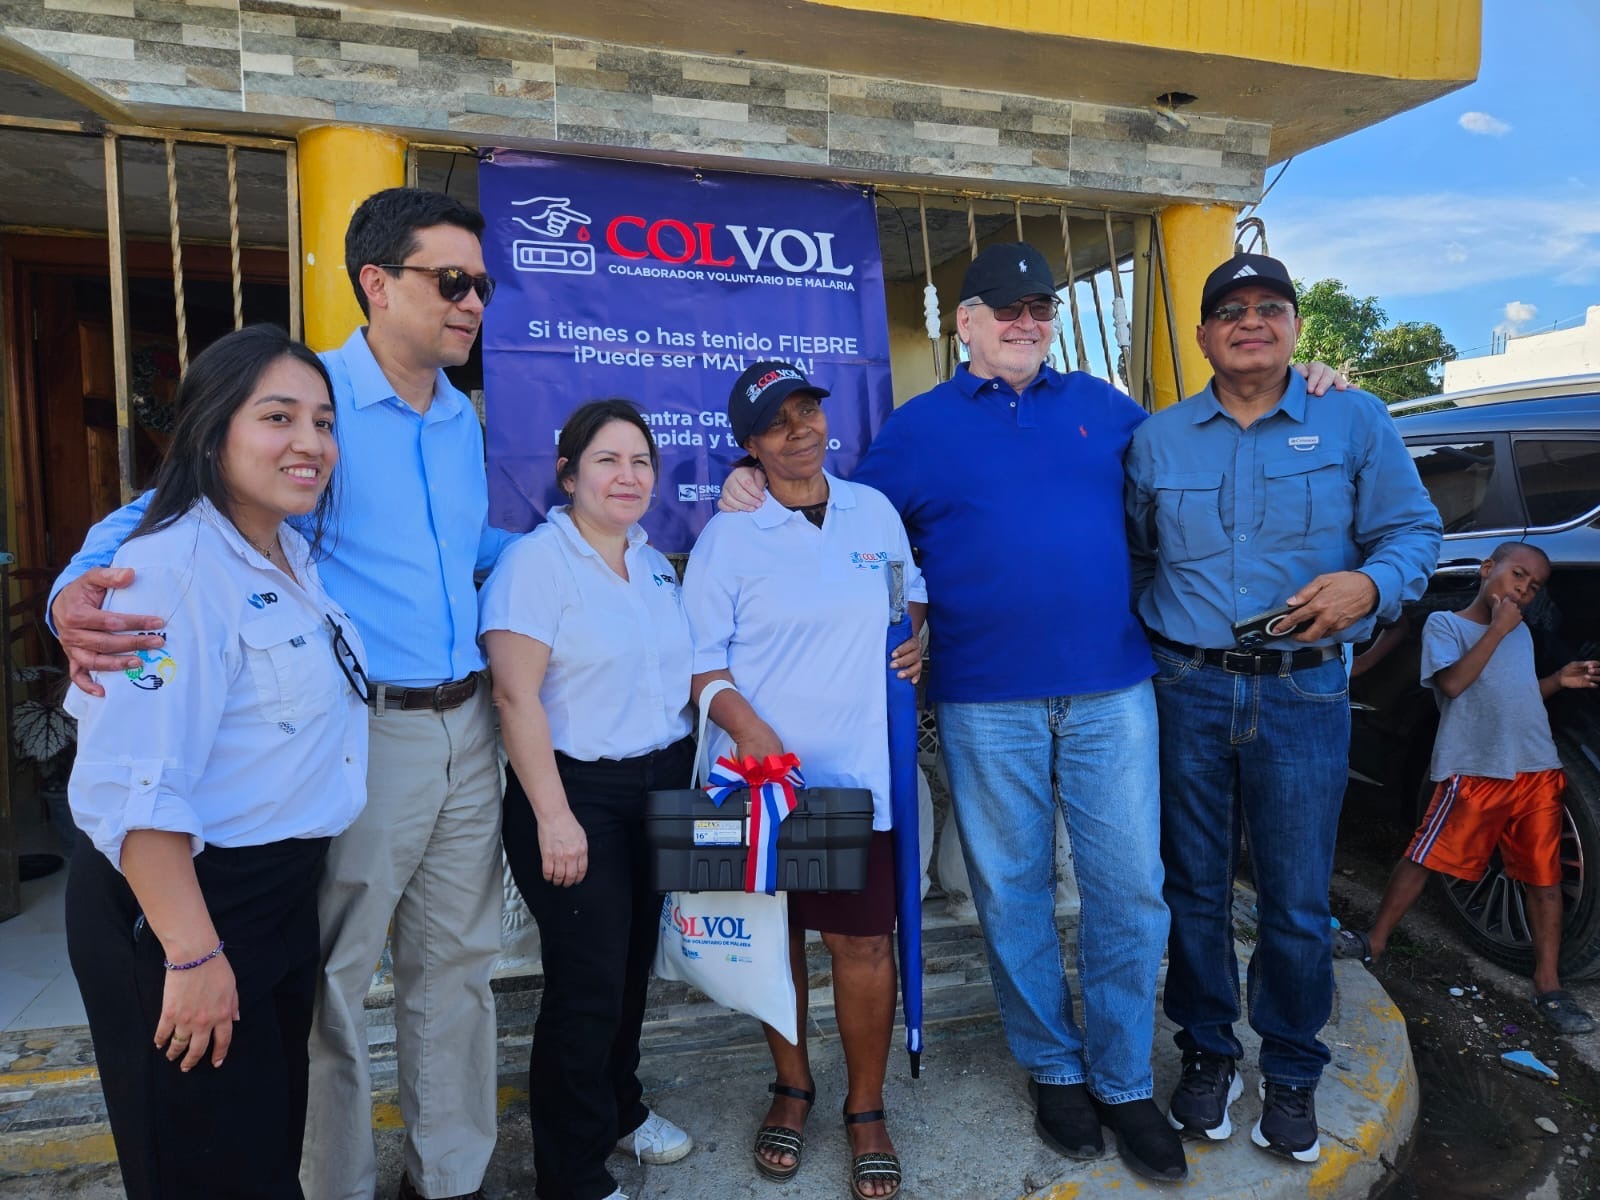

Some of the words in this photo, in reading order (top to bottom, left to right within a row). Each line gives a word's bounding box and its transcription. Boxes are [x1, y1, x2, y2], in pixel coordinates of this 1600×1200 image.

[606, 215, 854, 276] COLVOL
[608, 264, 704, 280] COLABORADOR
[706, 271, 784, 286] VOLUNTARIO
[786, 277, 803, 287] DE
[805, 278, 855, 292] MALARIA
[528, 320, 551, 339] Si
[557, 321, 629, 342] tienes
[635, 330, 650, 344] o
[657, 327, 696, 347] has
[701, 330, 773, 351] tenido
[779, 334, 859, 355] FIEBRE
[574, 345, 655, 367] ¡Puede
[662, 354, 696, 368] ser
[708, 433, 721, 449] y
[699, 485, 721, 494] SNS
